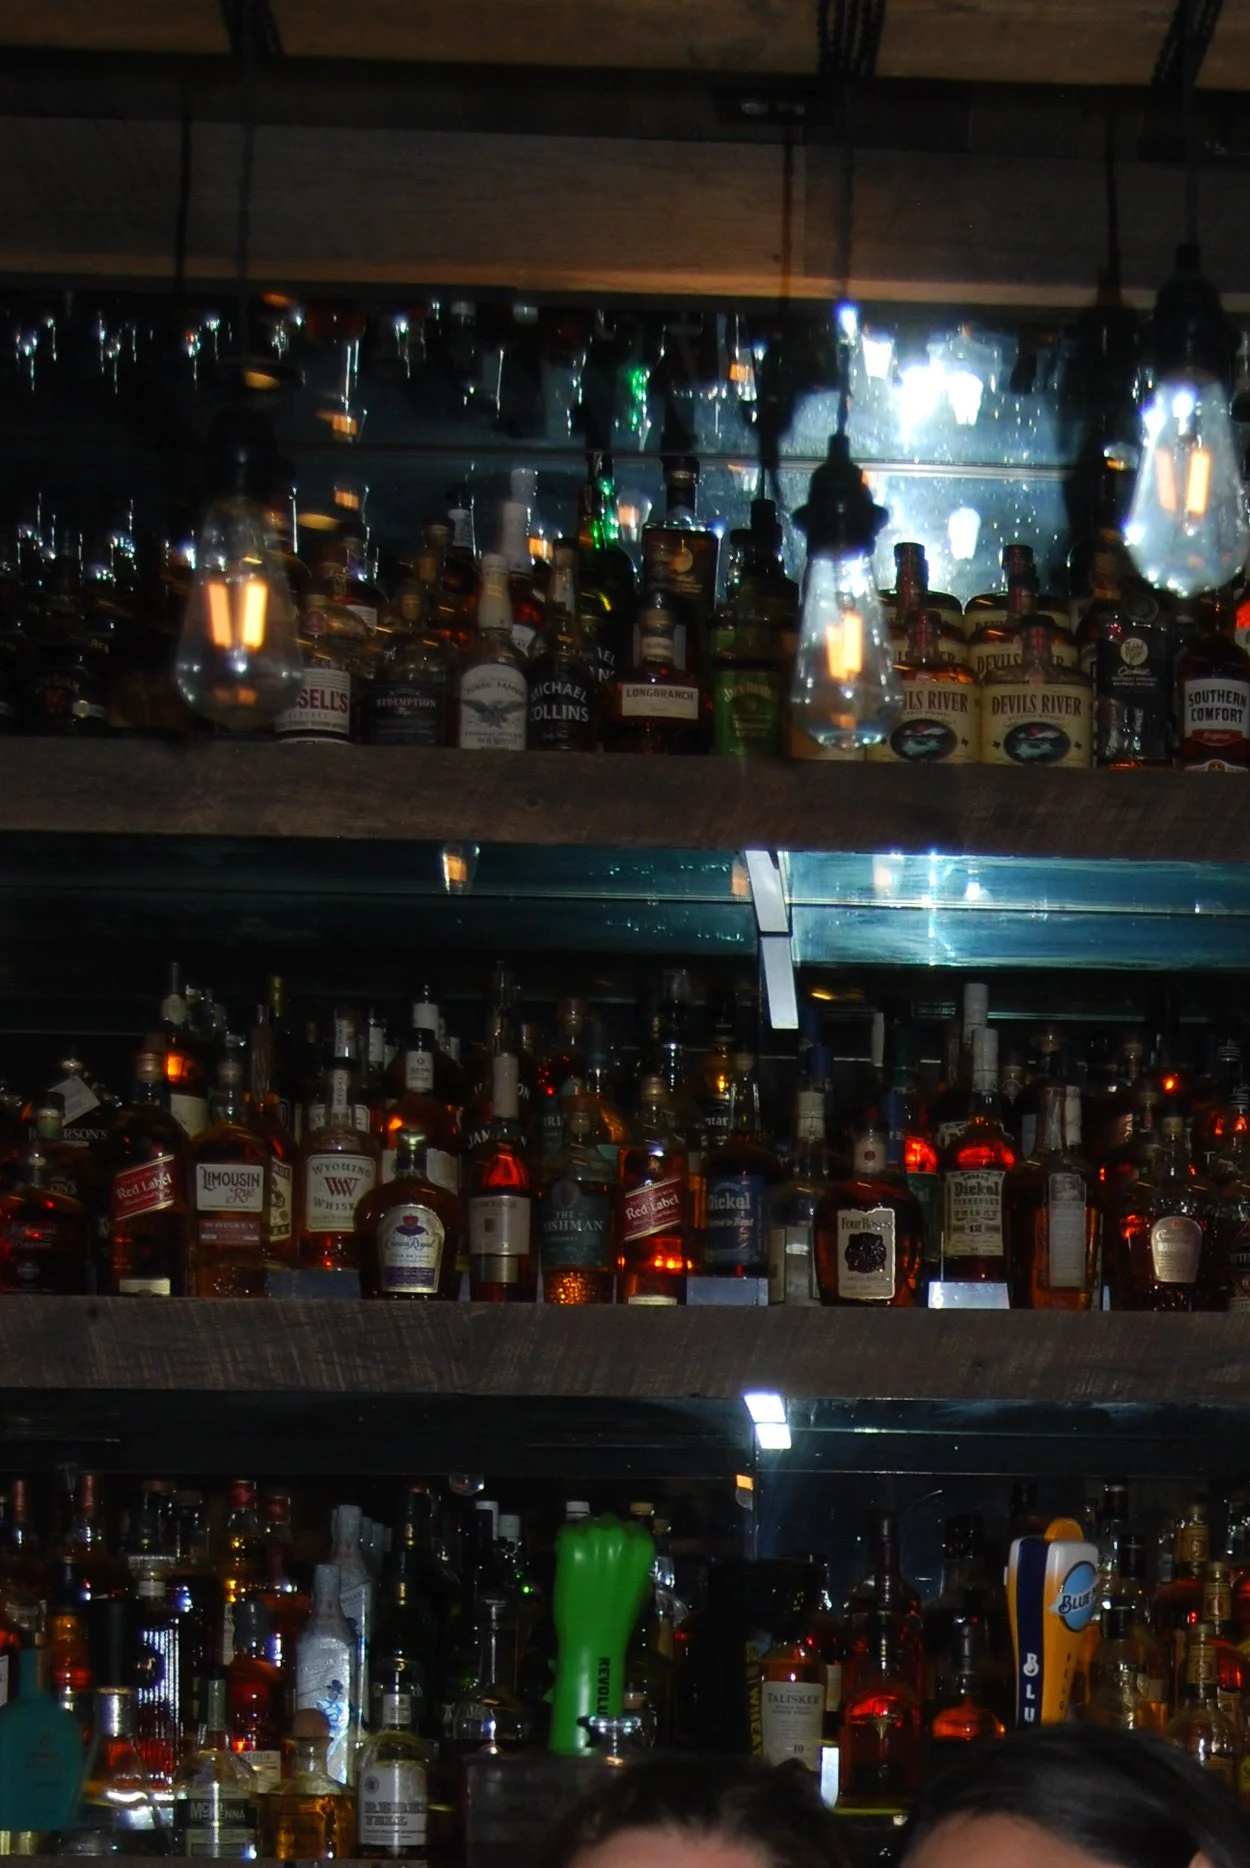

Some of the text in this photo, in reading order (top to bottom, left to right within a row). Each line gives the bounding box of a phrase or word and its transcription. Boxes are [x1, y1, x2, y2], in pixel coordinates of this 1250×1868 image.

[529, 680, 588, 704] MICHAEL
[626, 687, 694, 701] LONGBRANCH
[1188, 689, 1247, 707] SOUTHERN
[375, 697, 436, 708] REDEMPTION
[928, 691, 968, 713] RIVER
[991, 694, 1082, 715] DEVILS RIVER
[529, 703, 589, 723] COLLINS
[1191, 707, 1244, 723] COMFORT
[202, 1166, 260, 1190] LIMOUSIN
[312, 1160, 373, 1178] WYOMING
[116, 1173, 173, 1200] Red Label
[557, 1210, 575, 1219] THE
[625, 1193, 679, 1221] Red Label
[841, 1217, 861, 1230] Four
[767, 1692, 820, 1704] TALISKER
